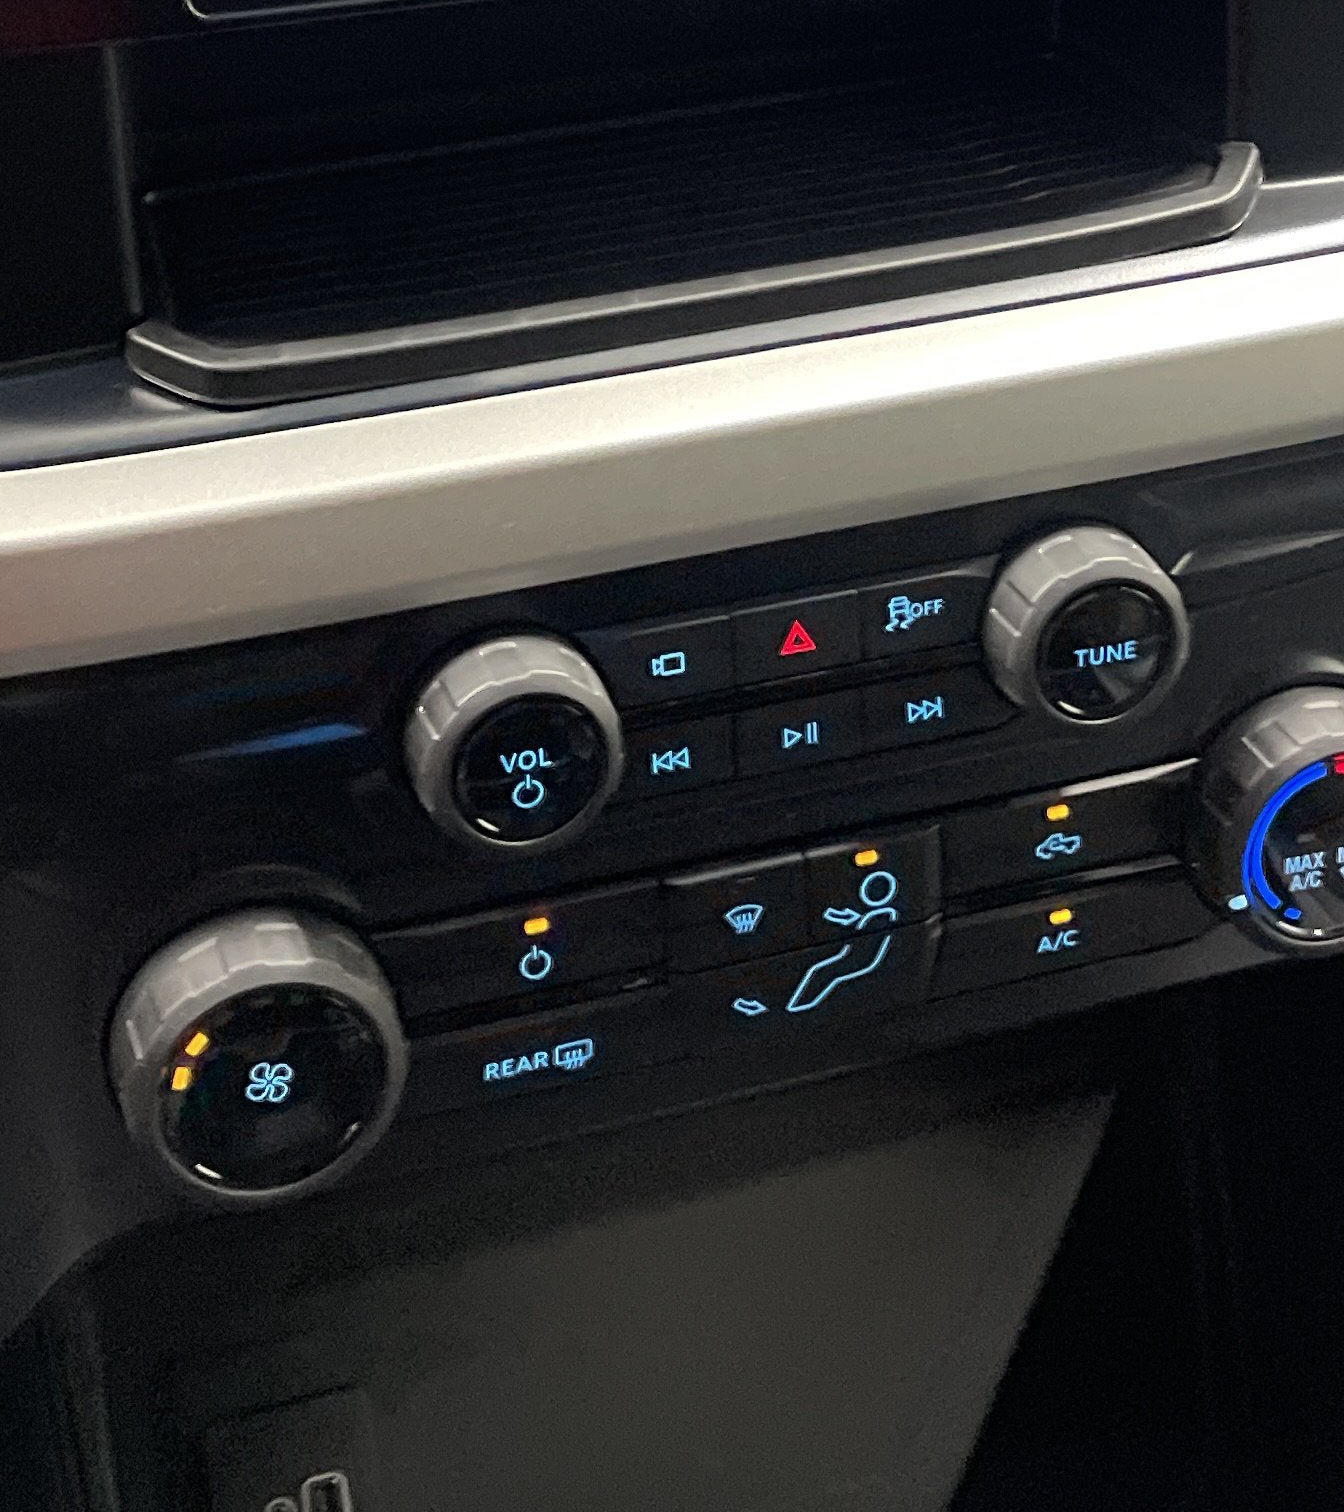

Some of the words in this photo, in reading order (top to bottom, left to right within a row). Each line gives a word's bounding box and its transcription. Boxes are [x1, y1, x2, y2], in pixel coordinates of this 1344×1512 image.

[911, 598, 944, 618] OFF
[1074, 640, 1136, 667] TUNE
[500, 748, 553, 773] VOL
[1284, 852, 1325, 875] MAX
[1289, 871, 1324, 891] A/C
[1038, 930, 1077, 952] A/C
[484, 1052, 548, 1080] REAR
